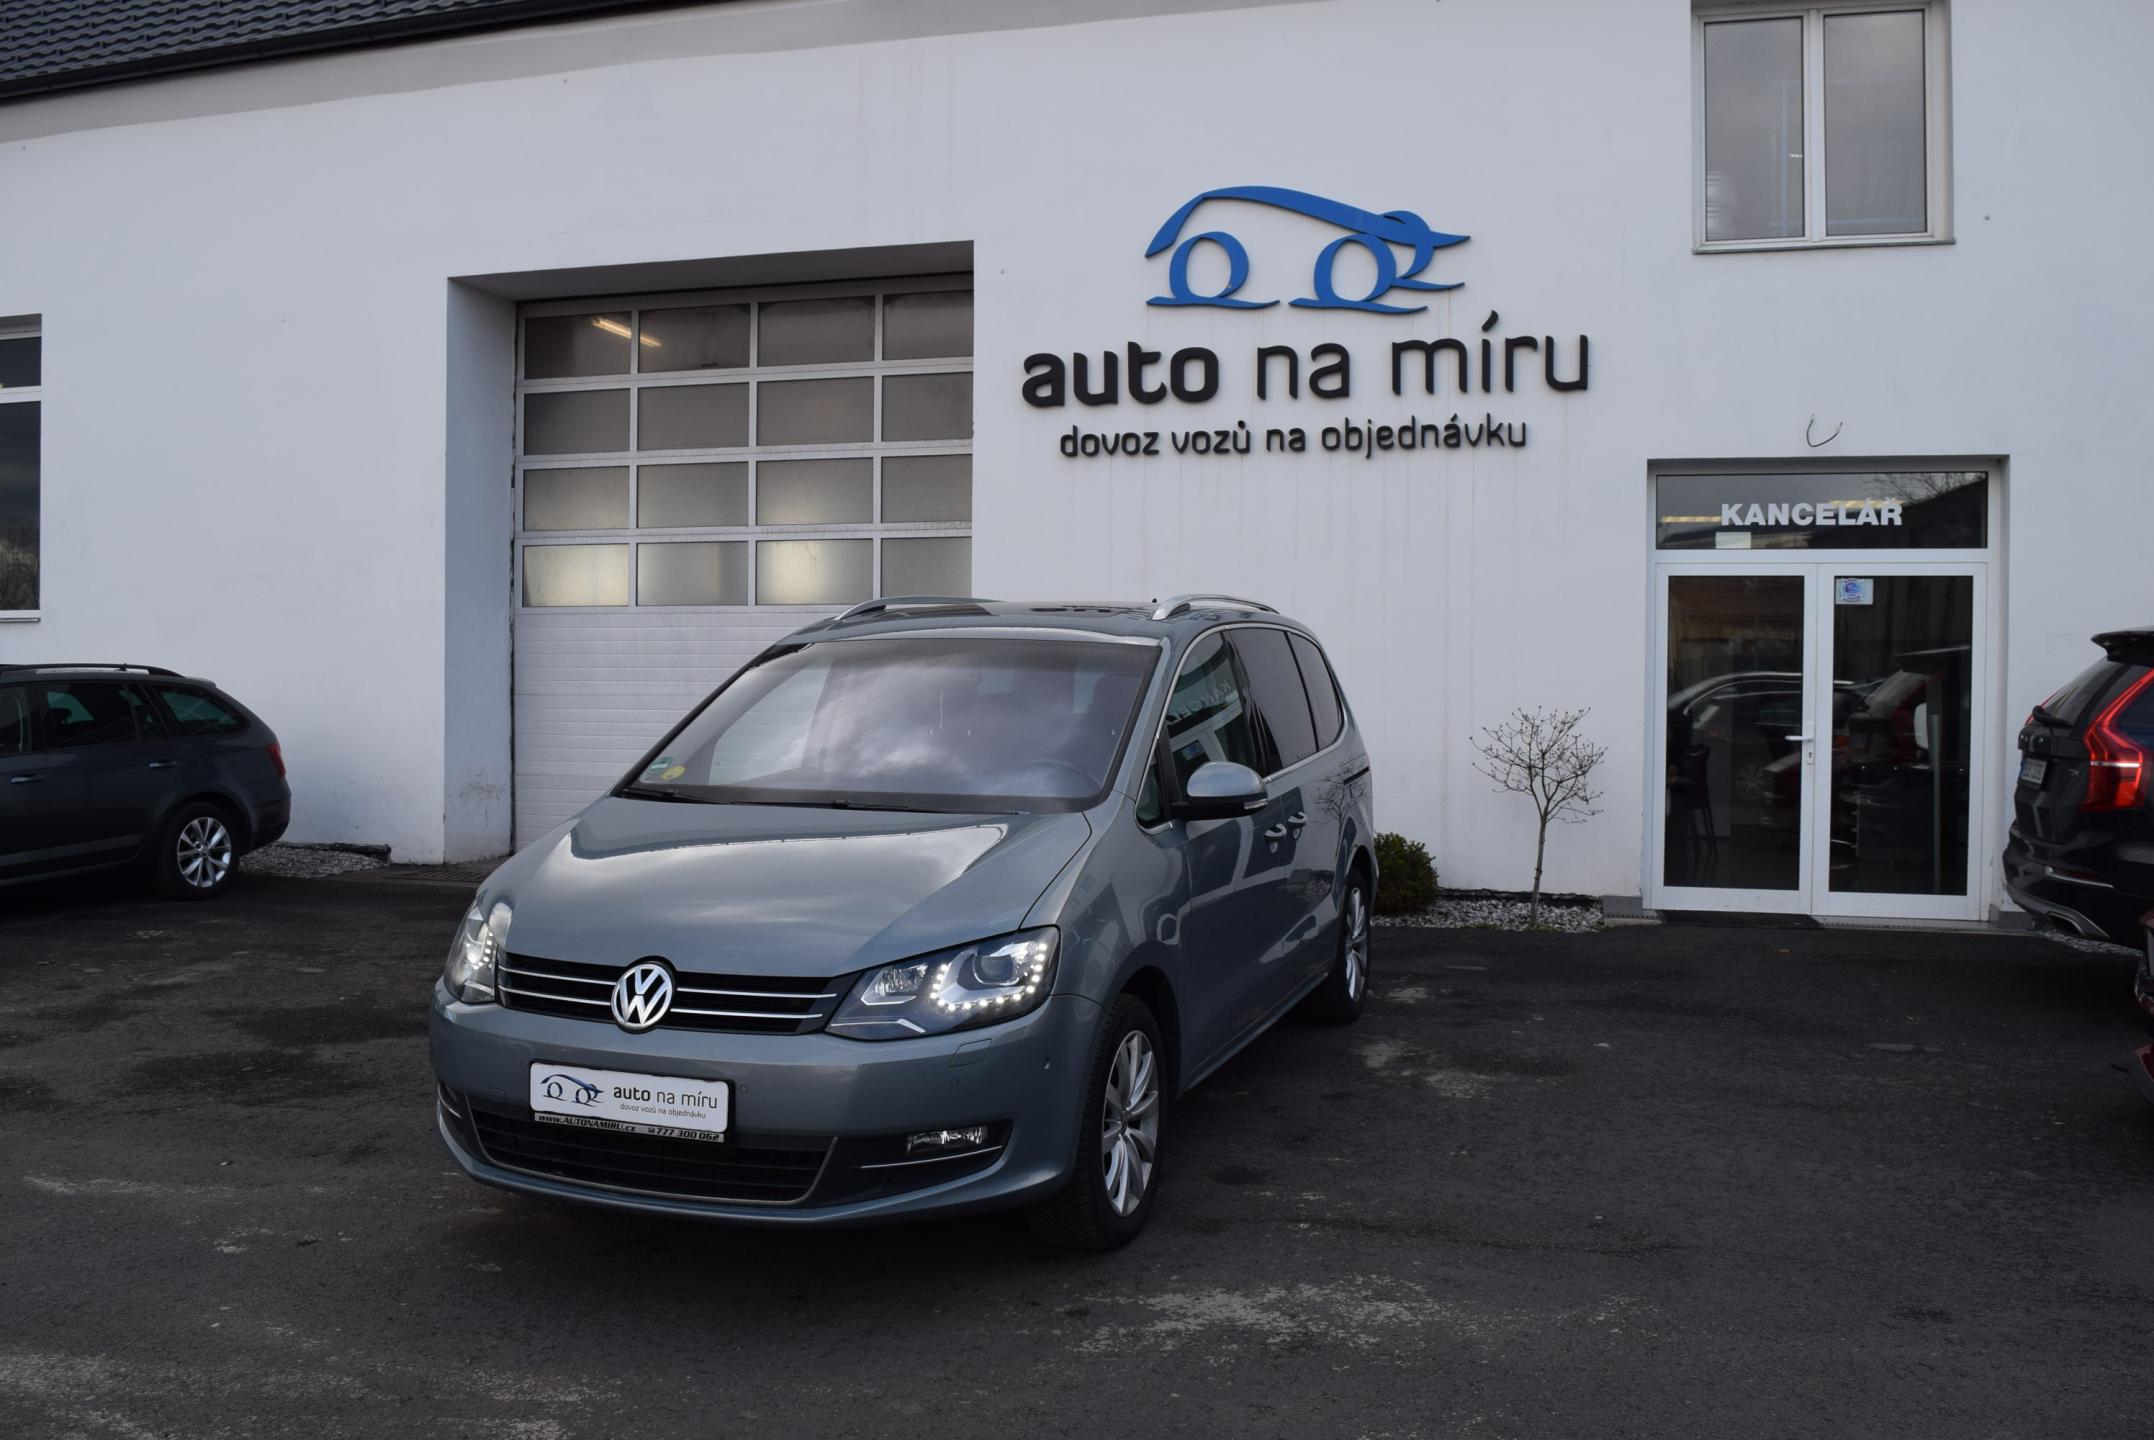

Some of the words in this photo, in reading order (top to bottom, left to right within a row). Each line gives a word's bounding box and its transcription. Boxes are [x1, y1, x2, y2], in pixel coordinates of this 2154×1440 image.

[1022, 341, 1219, 407] auto
[1257, 341, 1350, 400] na
[1391, 310, 1589, 395] míru
[1059, 425, 1159, 457] dovoz
[1171, 420, 1251, 454] vozů
[1266, 425, 1306, 453] na
[1321, 413, 1527, 459] objednávku
[1721, 497, 1903, 526] KANCELÁŘ
[613, 1086, 651, 1102] auto
[656, 1091, 675, 1104] na
[681, 1090, 717, 1109] míru
[620, 1103, 639, 1112] dovoz
[668, 1108, 706, 1119] objednávku
[656, 1127, 674, 1137] 777
